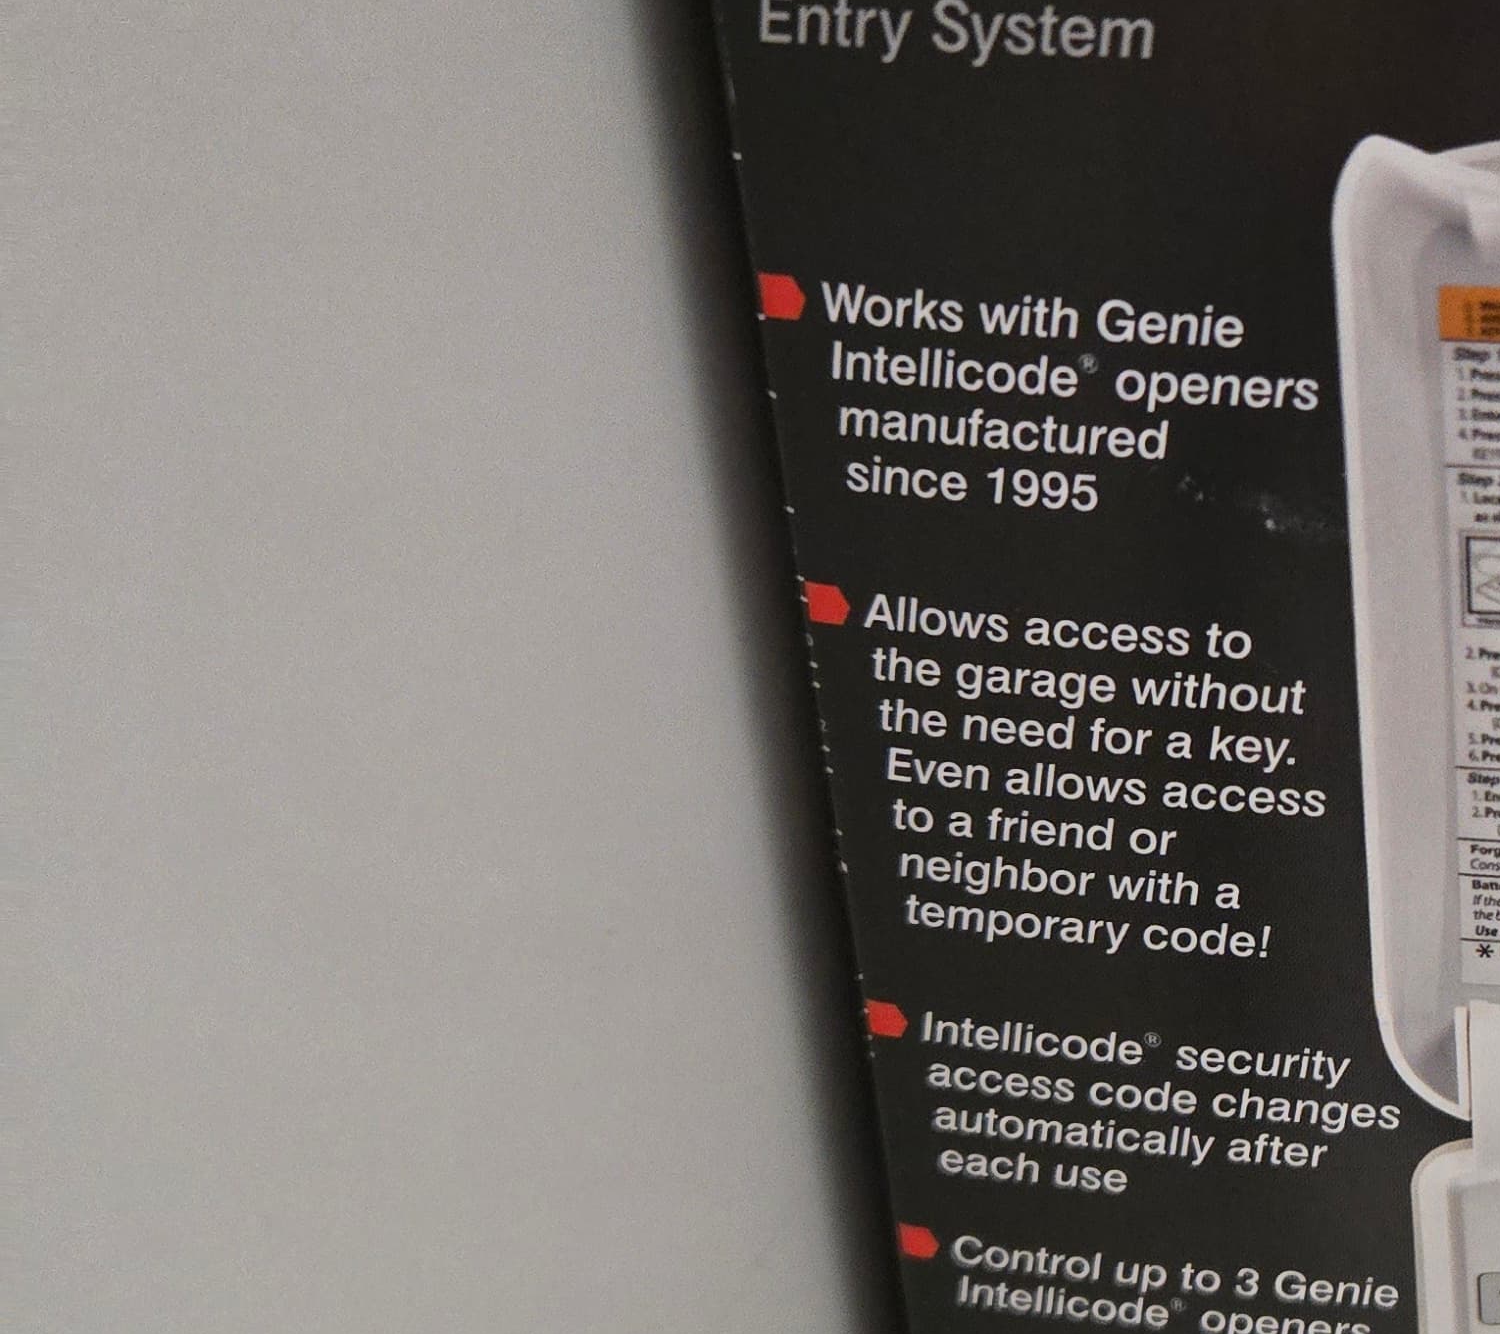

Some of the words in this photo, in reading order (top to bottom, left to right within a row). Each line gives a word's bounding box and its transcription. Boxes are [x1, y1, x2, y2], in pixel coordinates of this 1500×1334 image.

[821, 280, 964, 335] Works
[980, 294, 1080, 340] with
[1097, 298, 1245, 349] Genie
[1115, 368, 1321, 414] openers
[838, 402, 1170, 461] manufactured
[845, 455, 968, 502] since
[986, 467, 1100, 513] 1995
[863, 593, 1010, 645] Allows
[1023, 612, 1191, 658] access
[1206, 621, 1253, 660] to
[872, 646, 942, 687] the
[955, 658, 1117, 710] garage
[1132, 670, 1308, 716] without
[879, 698, 949, 739] the
[962, 714, 1075, 752] need
[1090, 719, 1154, 757] for
[1166, 730, 1194, 761] a
[1209, 725, 1297, 774] key.
[885, 746, 990, 792] Even
[1005, 761, 1148, 806] allows
[1161, 779, 1328, 818] access
[1467, 772, 1500, 787] Step
[892, 797, 935, 834] to
[947, 808, 975, 839] a
[987, 806, 1115, 853] friend
[1128, 826, 1178, 856] or
[899, 851, 1097, 897] neighbor
[1107, 869, 1200, 907] with
[1214, 878, 1241, 909] a
[1473, 895, 1483, 906] If
[905, 892, 1131, 954] temporary
[1142, 922, 1273, 959] code!
[1473, 910, 1493, 921] the
[1475, 925, 1498, 937] Use
[1175, 1041, 1353, 1089] security
[927, 1061, 1077, 1103] access
[1089, 1077, 1198, 1115] code
[1212, 1088, 1402, 1134] changes
[932, 1104, 1216, 1167] automatically
[1227, 1132, 1329, 1169] after
[938, 1146, 1040, 1184] each
[1053, 1163, 1129, 1194] use
[951, 1234, 1103, 1283] Control
[1114, 1257, 1167, 1294] up
[1180, 1259, 1221, 1293] to
[1234, 1265, 1260, 1298] 3
[1273, 1269, 1401, 1309] Genie
